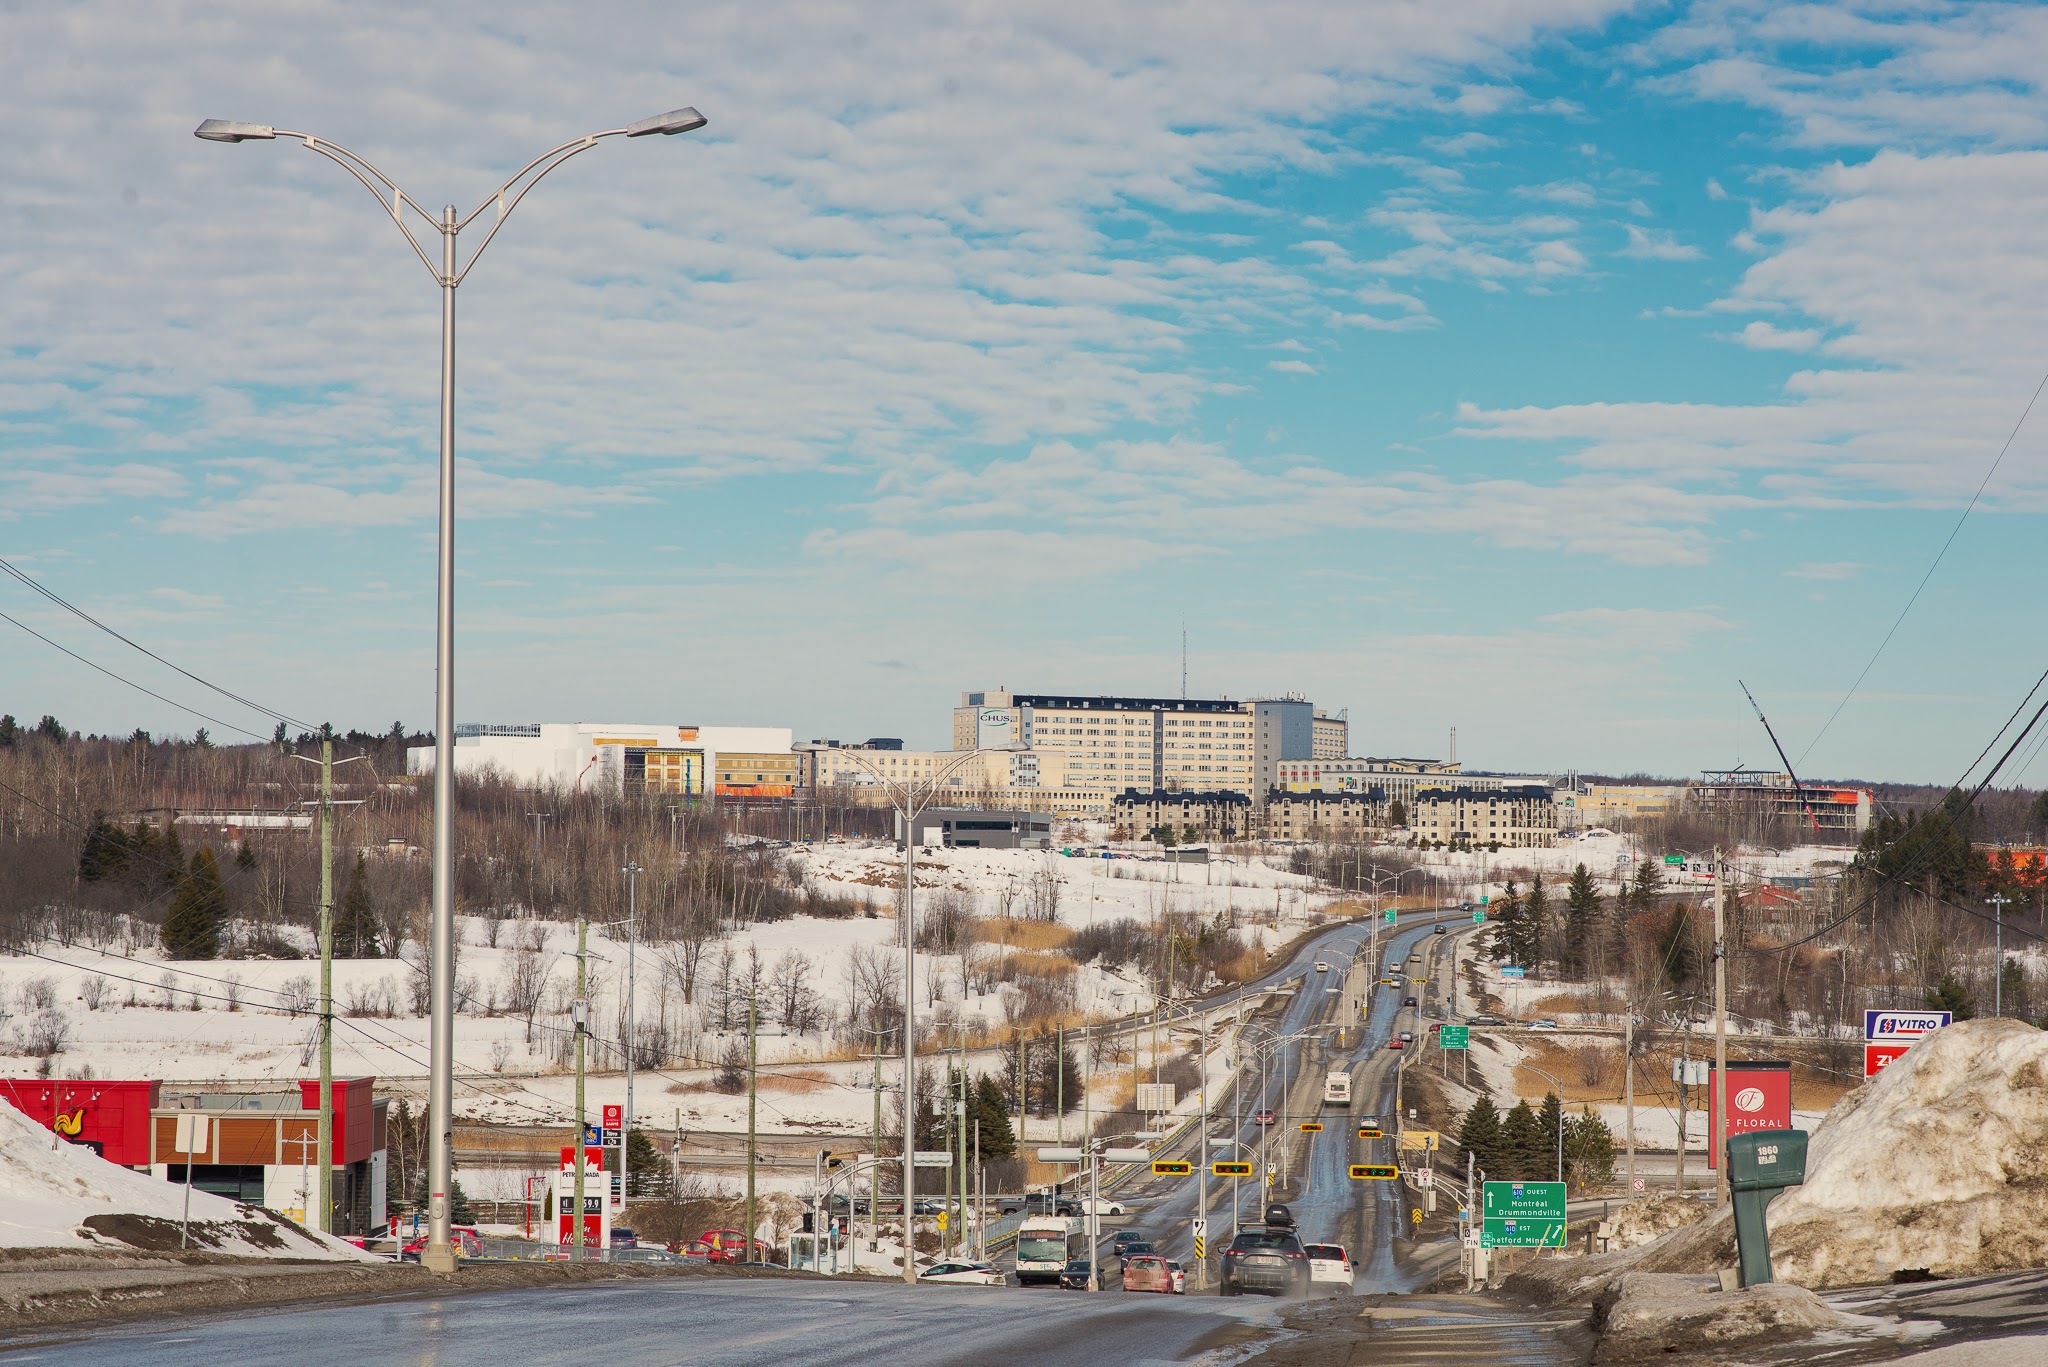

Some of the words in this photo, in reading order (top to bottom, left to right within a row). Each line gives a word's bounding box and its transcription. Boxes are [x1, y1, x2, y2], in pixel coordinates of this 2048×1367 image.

[1898, 1019, 1937, 1029] VITRO
[1736, 1119, 1782, 1127] FLORAL
[1757, 1145, 1778, 1155] 1860
